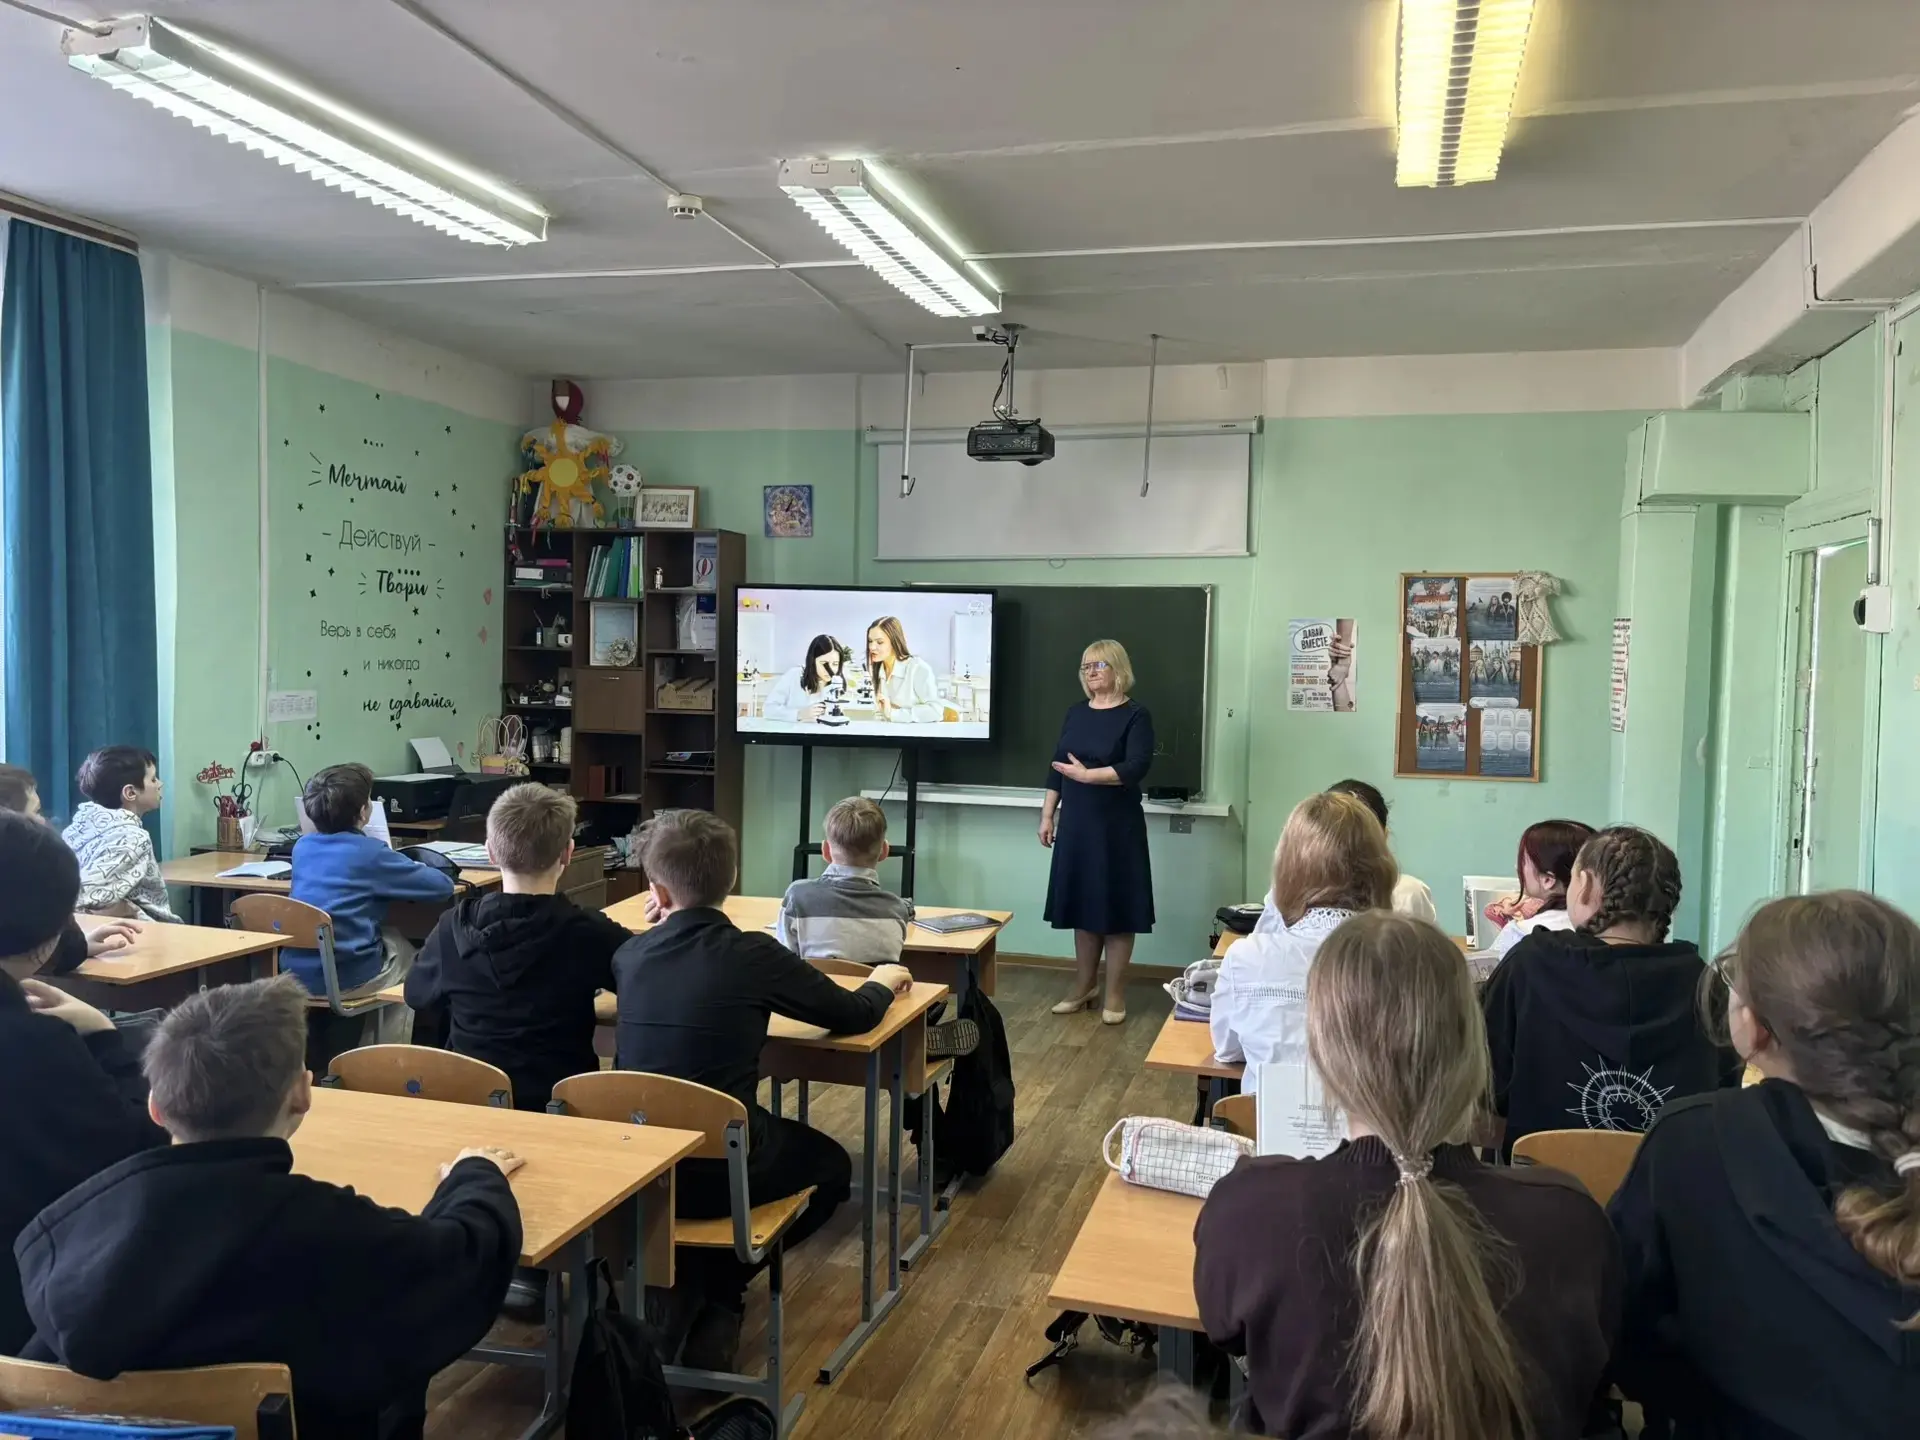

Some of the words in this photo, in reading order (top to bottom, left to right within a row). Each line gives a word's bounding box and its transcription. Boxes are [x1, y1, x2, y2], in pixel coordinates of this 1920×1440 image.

[328, 463, 407, 494] Мечтай
[339, 519, 421, 556] Действуй
[376, 569, 428, 602] Твори
[320, 619, 351, 643] Верь
[356, 626, 361, 637] в
[366, 623, 397, 639] себя
[1301, 637, 1328, 649] ВМЕСТЕ
[1303, 626, 1324, 639] ДАВАЙ
[363, 659, 371, 670] и
[377, 658, 420, 671] никогда
[362, 699, 381, 711] не
[389, 691, 454, 720] сдавайся
